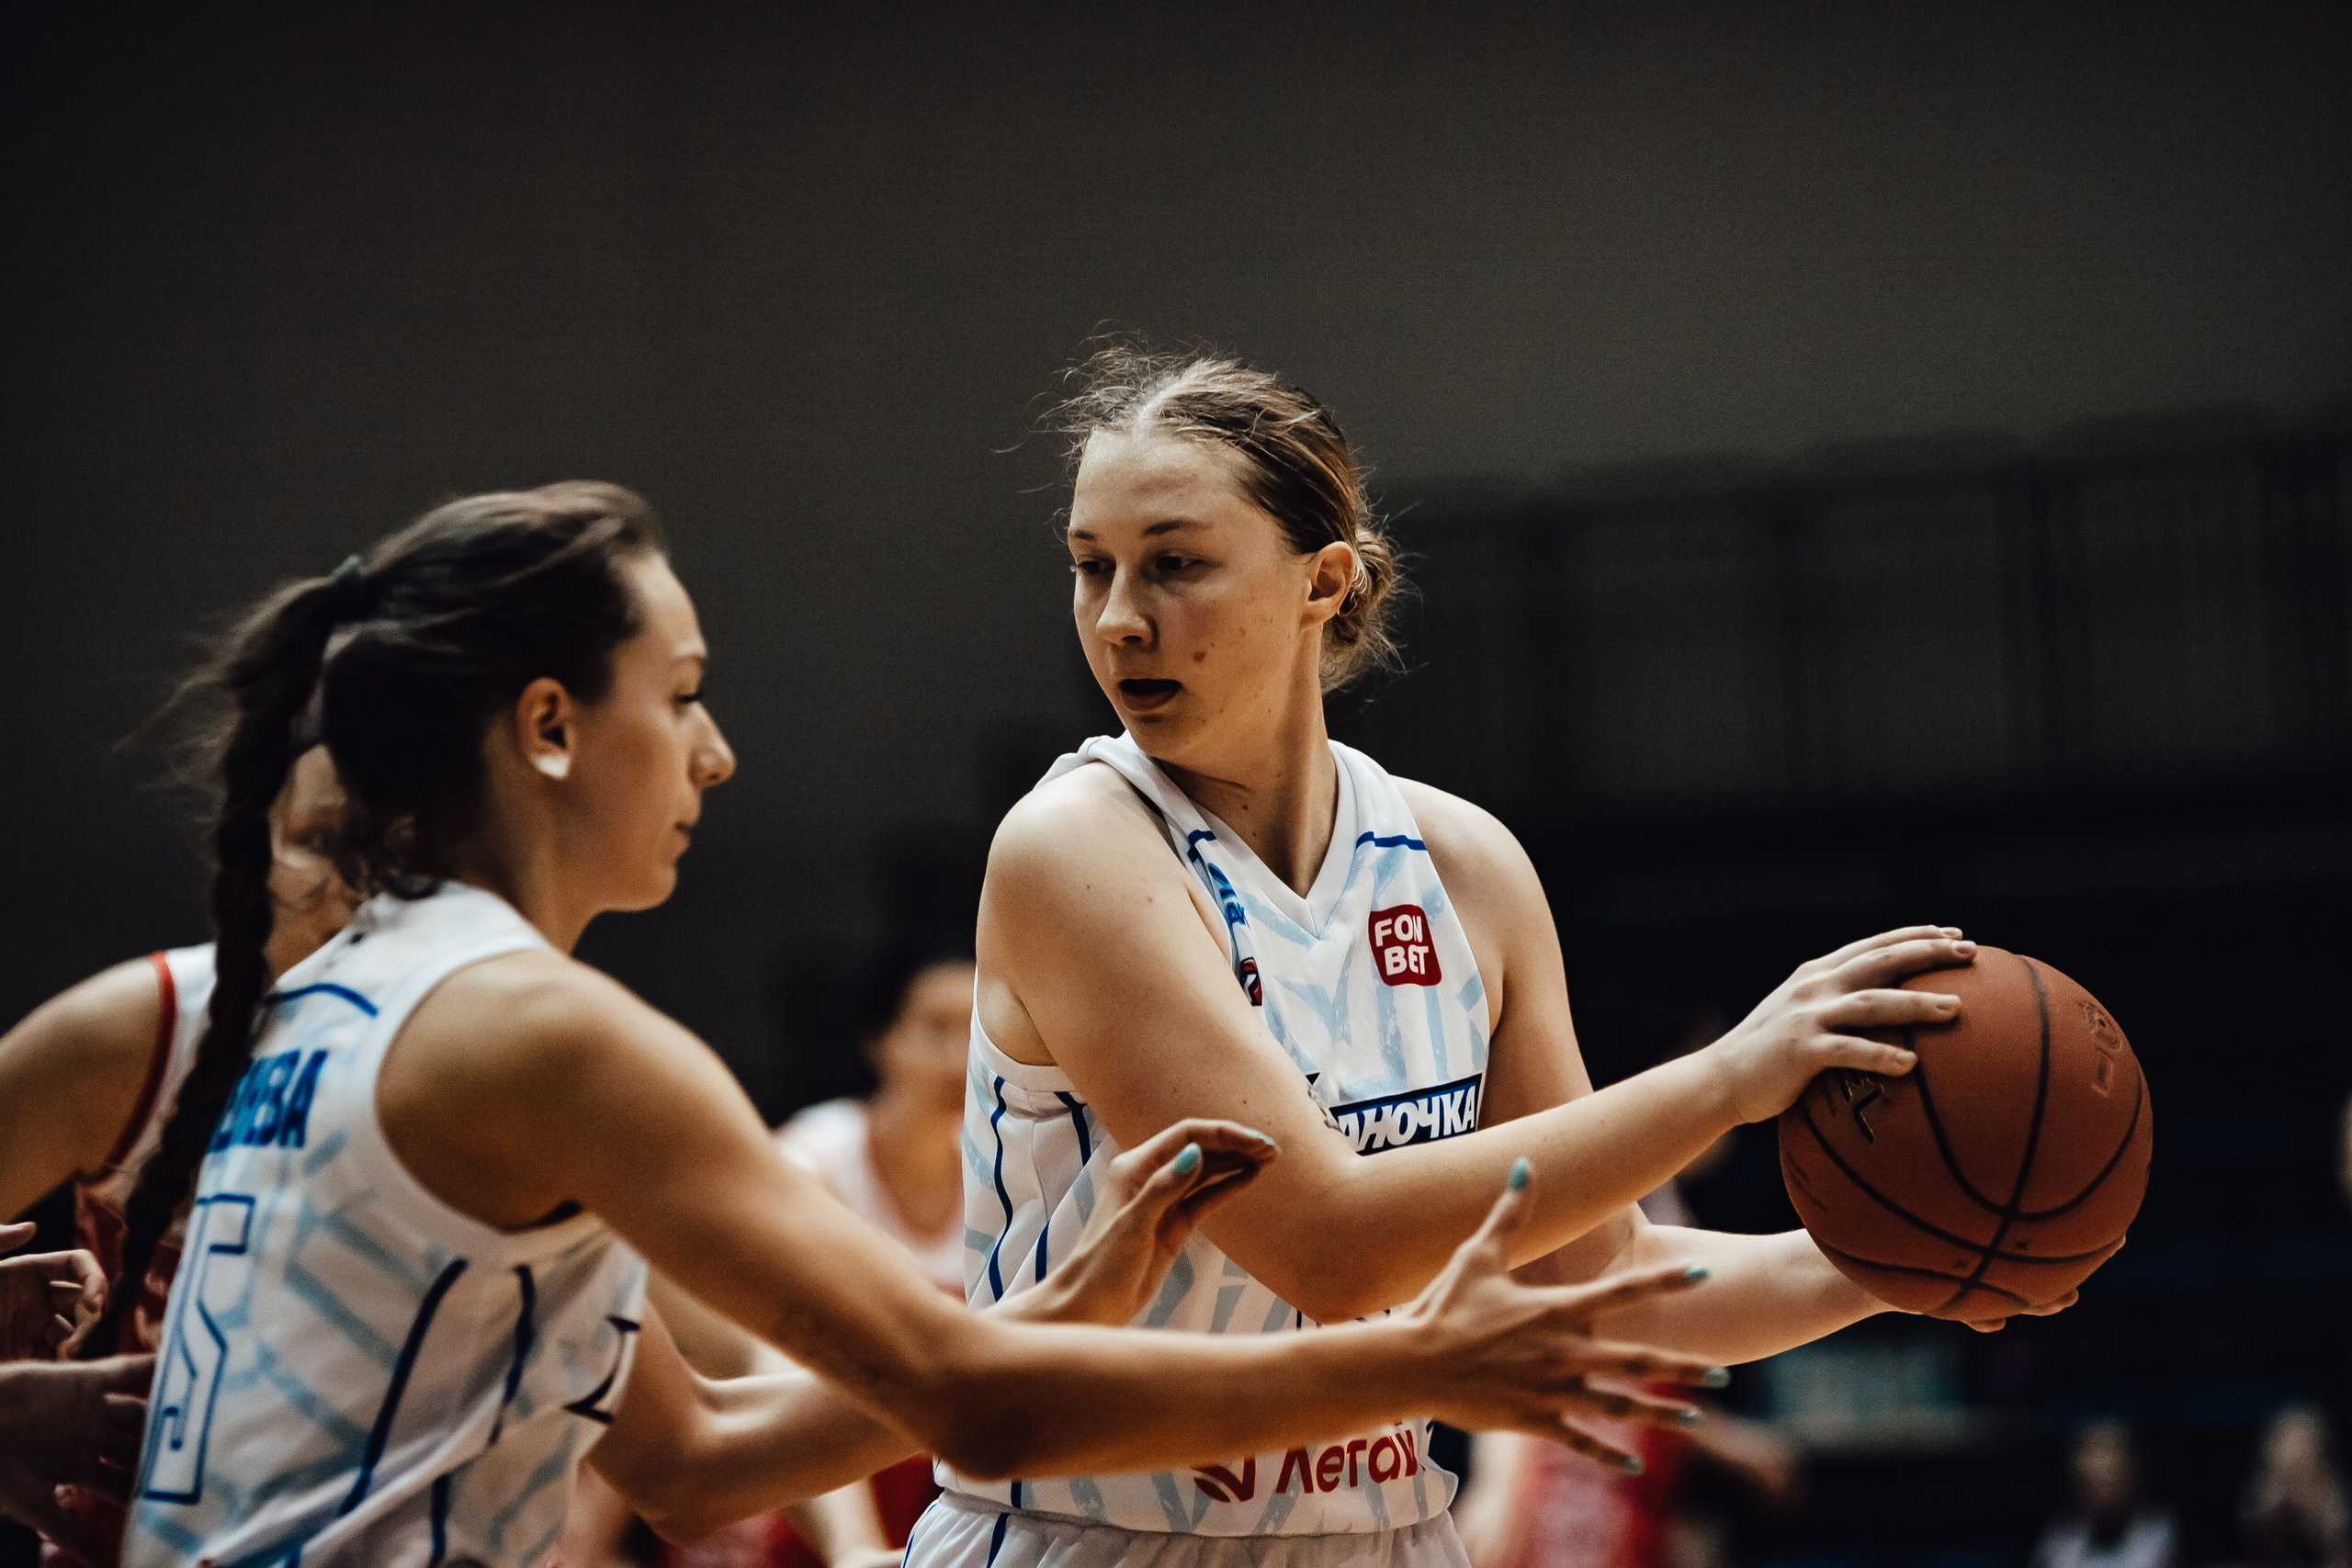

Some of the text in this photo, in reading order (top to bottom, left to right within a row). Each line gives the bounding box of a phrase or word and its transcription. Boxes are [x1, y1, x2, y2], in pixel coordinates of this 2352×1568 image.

[1374, 914, 1423, 947] FON
[1384, 944, 1429, 976] BET
[1337, 1085, 1476, 1152] АНОЧКА
